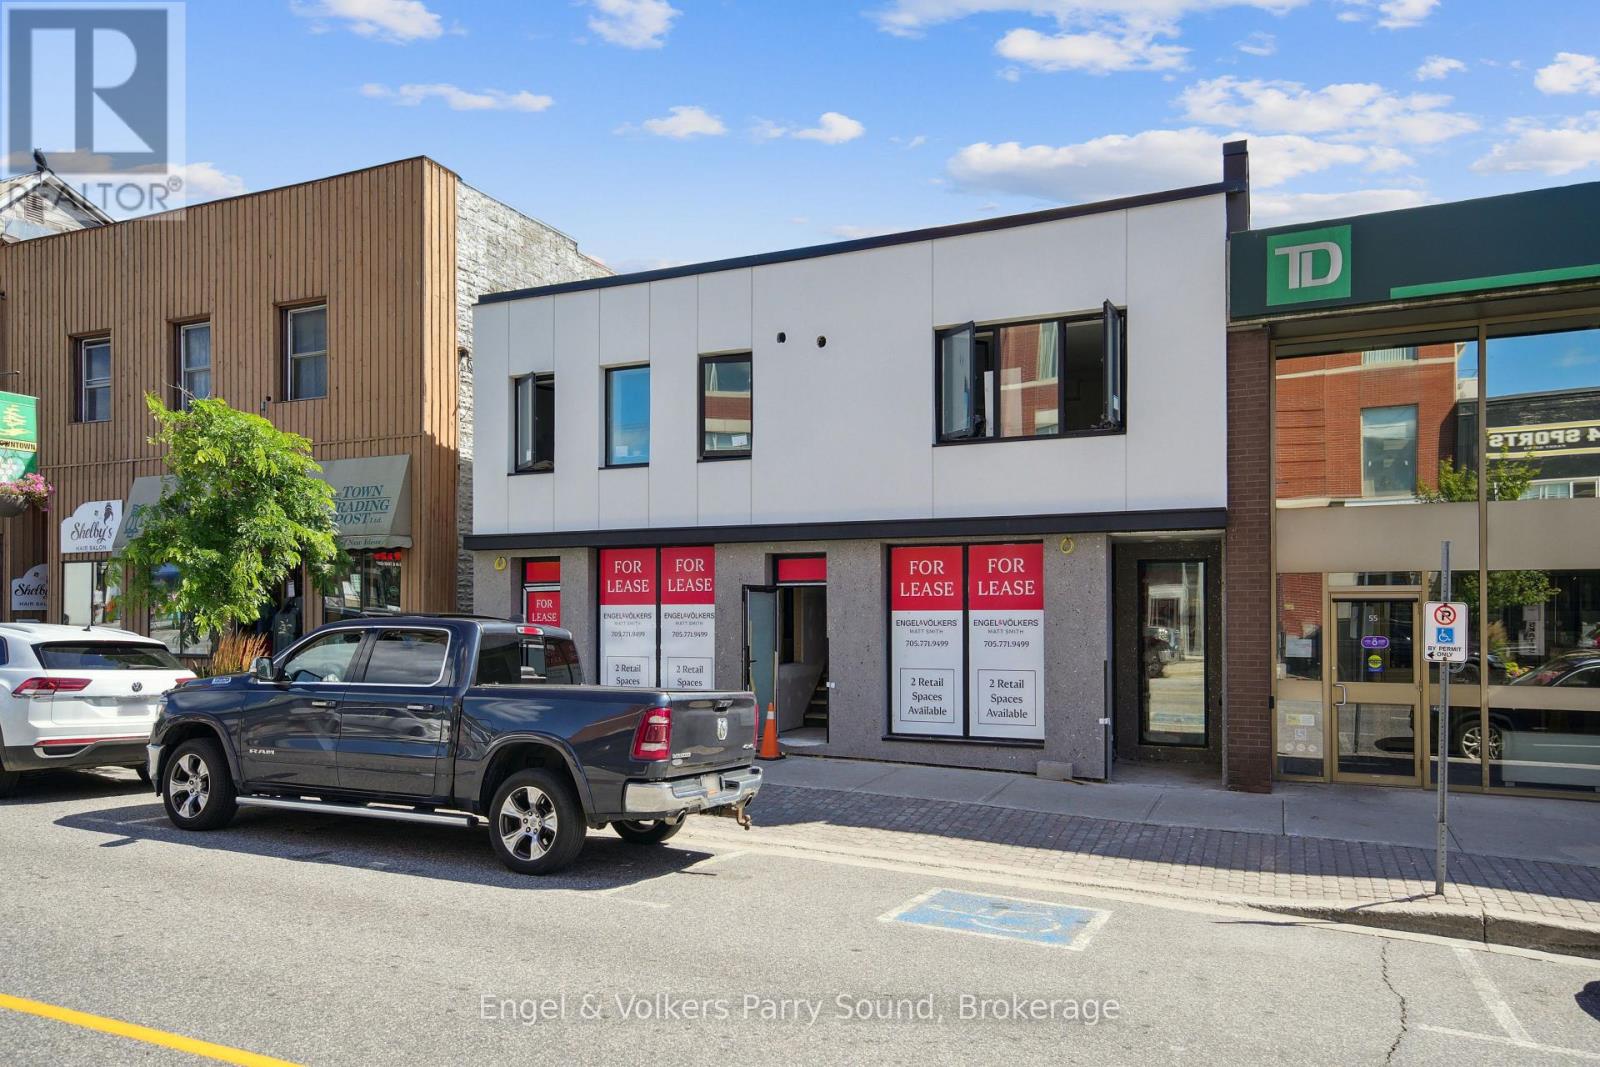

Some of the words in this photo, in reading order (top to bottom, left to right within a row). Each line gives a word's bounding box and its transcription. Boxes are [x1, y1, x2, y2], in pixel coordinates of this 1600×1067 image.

[1275, 241, 1343, 289] TD
[343, 485, 384, 498] TOWN
[335, 513, 371, 525] POST
[70, 521, 113, 542] Shelby's
[614, 560, 642, 574] FOR
[676, 558, 705, 572] FOR
[909, 560, 944, 575] FOR
[987, 558, 1025, 573] FOR
[607, 579, 650, 593] LEASE
[667, 578, 713, 592] LEASE
[900, 582, 955, 597] LEASE
[977, 580, 1036, 596] LEASE
[14, 583, 48, 600] Shelb
[536, 599, 553, 608] FOR
[532, 612, 558, 622] LEASE
[1368, 614, 1378, 622] 55
[905, 640, 949, 648] 705.771.9499
[983, 640, 1030, 648] 705.771.9499
[621, 664, 641, 672] Retail
[676, 665, 681, 673] 2
[682, 665, 704, 673] Retail
[616, 676, 640, 686] Spaces
[676, 678, 703, 688] Spaces
[910, 678, 916, 687] 2
[918, 677, 944, 687] Retail
[989, 679, 995, 688] 2
[997, 679, 1025, 689] Retail
[912, 692, 943, 702] Spaces
[990, 693, 1023, 705] Spaces
[907, 705, 947, 716] Available
[986, 707, 1028, 719] Available
